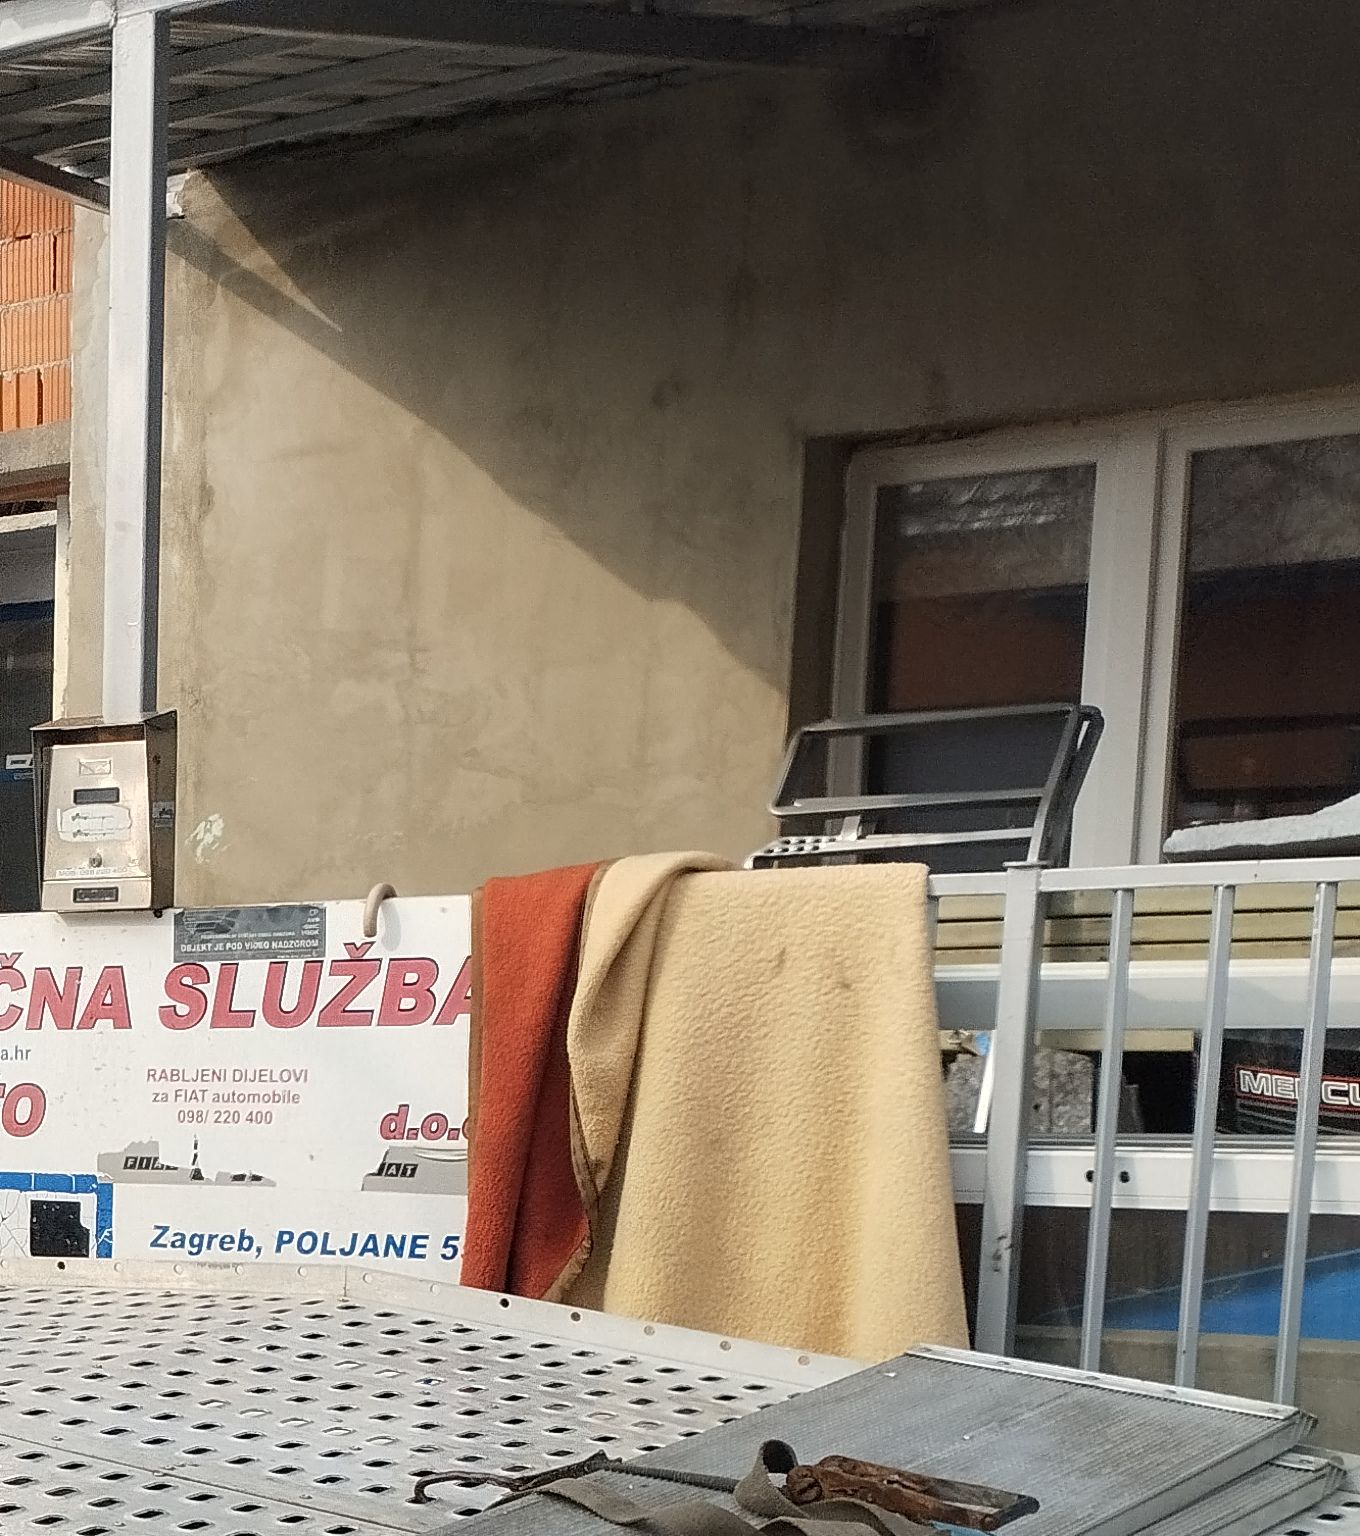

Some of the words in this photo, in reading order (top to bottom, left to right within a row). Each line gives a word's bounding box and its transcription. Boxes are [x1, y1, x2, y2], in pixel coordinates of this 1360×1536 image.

[158, 941, 472, 1030] SLUŽBA
[146, 1069, 227, 1083] RABLJENI
[232, 1069, 309, 1083] DIJELOVI
[152, 1091, 170, 1103] za
[174, 1089, 209, 1103] FIAT
[211, 1090, 301, 1105] automobile
[177, 1110, 210, 1124] 098/
[213, 1110, 241, 1124] 220
[245, 1110, 273, 1124] 400
[379, 1104, 469, 1142] d.o.
[149, 1225, 263, 1259] Zagreb,
[275, 1230, 429, 1260] POLJANE
